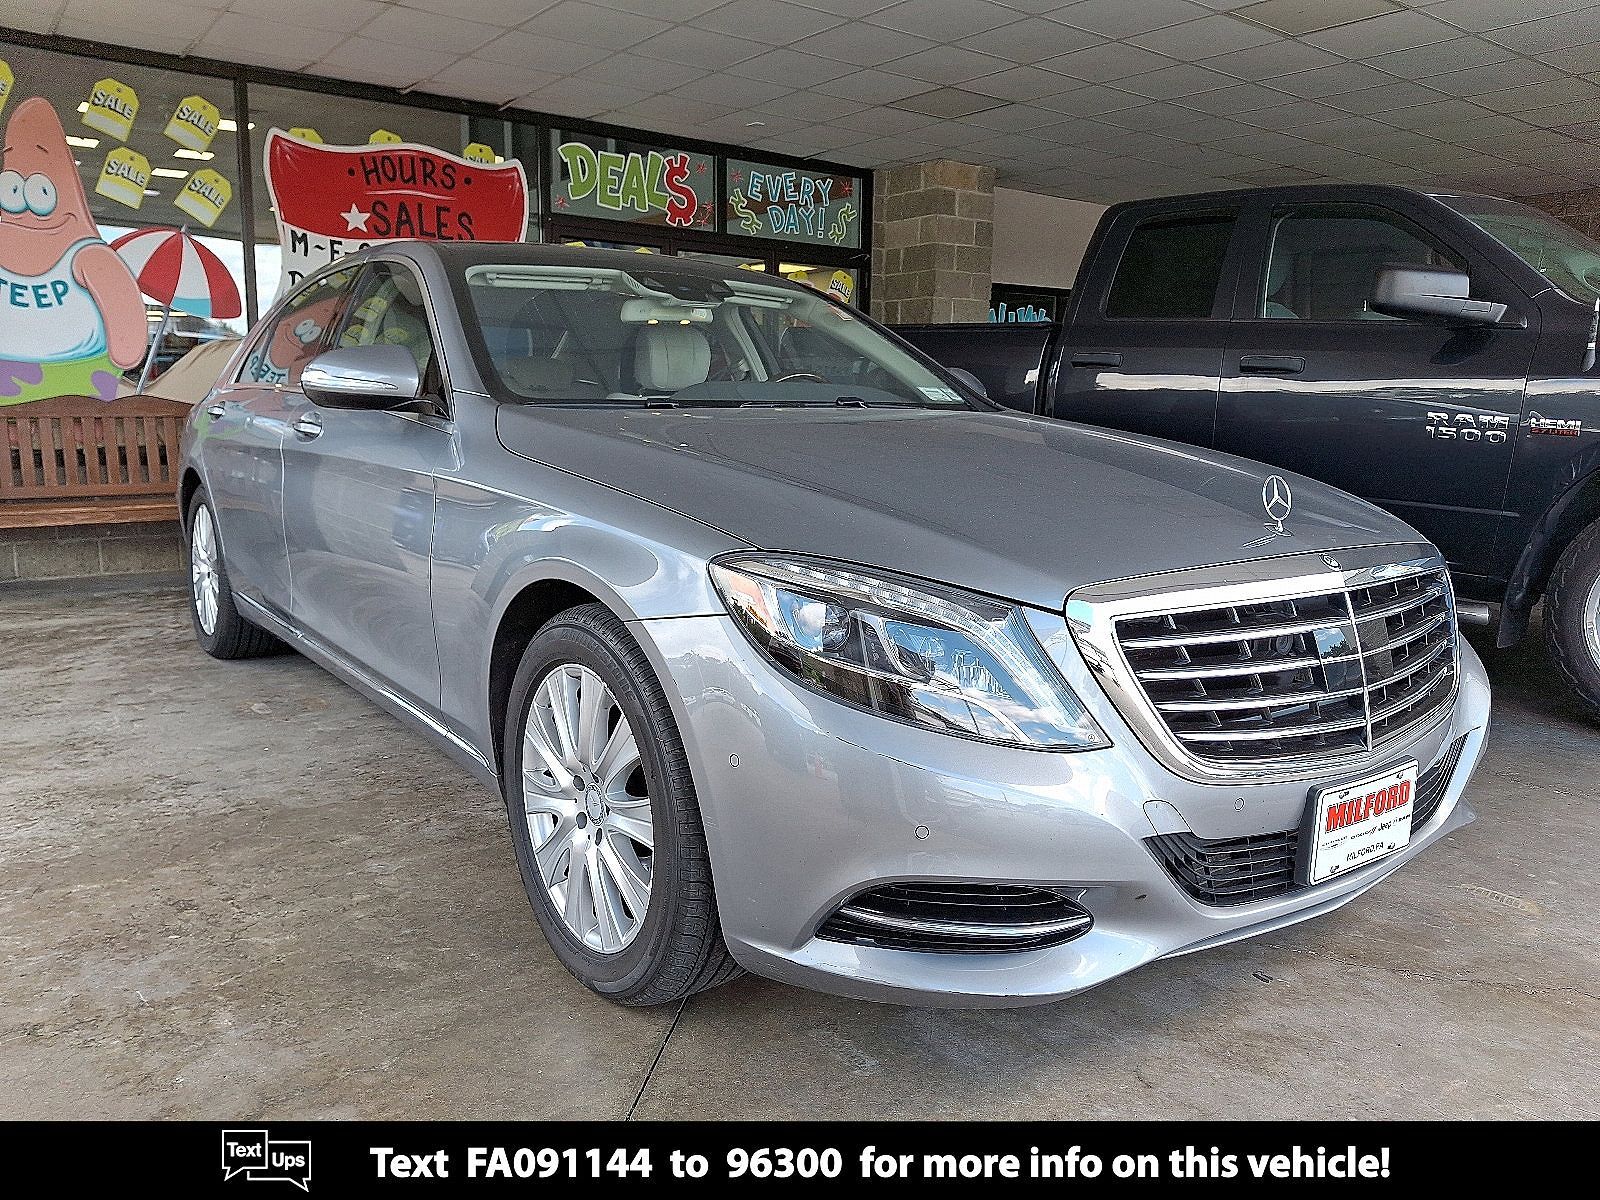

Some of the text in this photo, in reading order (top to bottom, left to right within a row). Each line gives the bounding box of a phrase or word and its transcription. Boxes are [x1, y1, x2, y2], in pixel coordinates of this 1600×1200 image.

[91, 89, 133, 120] SALE
[176, 104, 214, 136] SALE
[105, 158, 146, 188] SALE
[360, 154, 457, 191] HOURS
[187, 177, 224, 209] SALE
[748, 170, 834, 208] EVERY
[370, 200, 476, 241] SALES
[766, 203, 826, 238] DAY!
[831, 279, 852, 299] SALE
[1425, 425, 1508, 443] 1500
[1426, 411, 1510, 430] RAM
[1530, 417, 1582, 430] HEMI
[1325, 779, 1412, 834] MILFORD
